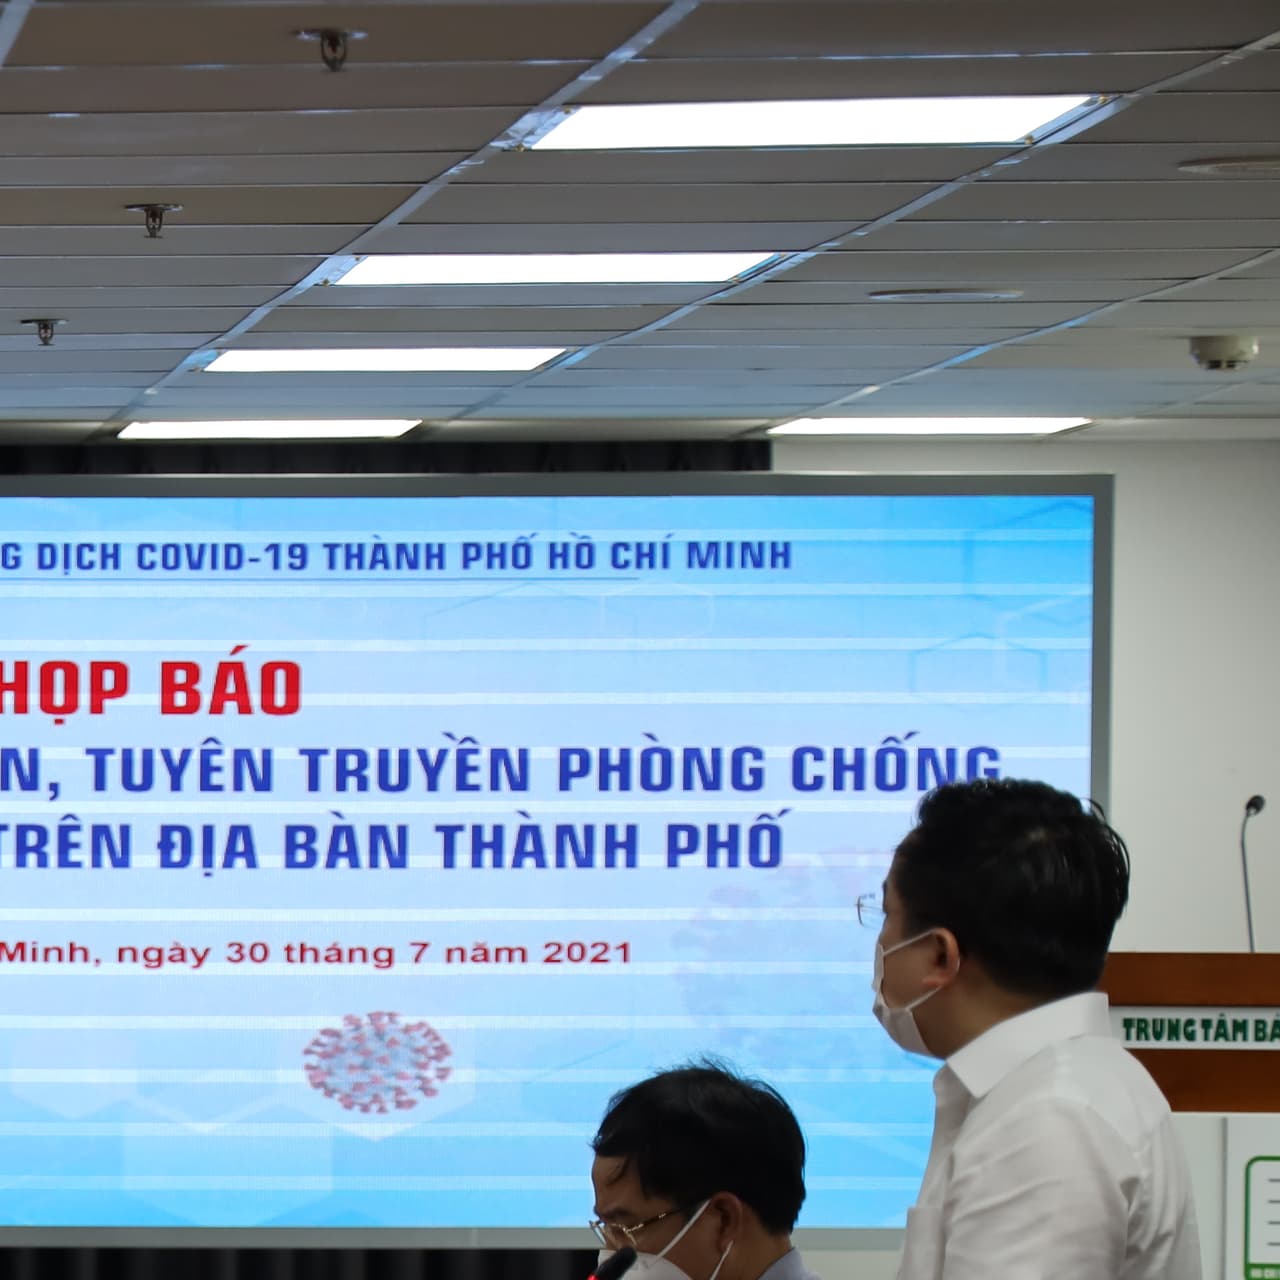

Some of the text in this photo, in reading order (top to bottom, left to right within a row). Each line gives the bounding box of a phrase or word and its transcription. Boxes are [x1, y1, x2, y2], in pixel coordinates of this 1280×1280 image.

[37, 543, 120, 574] DỊCH
[137, 543, 309, 571] COVID-19
[322, 534, 445, 570] THÀNH
[462, 533, 533, 570] PHỐ
[549, 532, 595, 570] HỒ
[611, 533, 671, 570] CHÍ
[687, 541, 791, 569] MINH
[160, 645, 302, 716] BÁO
[85, 737, 273, 792] TUYÊN
[299, 731, 530, 793] TRUYỀN
[558, 733, 765, 792] PHÒNG
[792, 731, 1001, 791] CHỐNG
[157, 823, 258, 877] ĐỊA
[284, 811, 408, 869] BÀN
[434, 811, 638, 869] THÀNH
[667, 809, 792, 869] PHỐ
[118, 942, 210, 969] ngày
[227, 942, 270, 963] 30
[284, 940, 395, 969] tháng
[410, 942, 430, 963] 7
[446, 941, 528, 964] năm
[543, 942, 631, 963] 2021
[1123, 1018, 1196, 1042] TRUNG
[1201, 1013, 1248, 1042] TÂM
